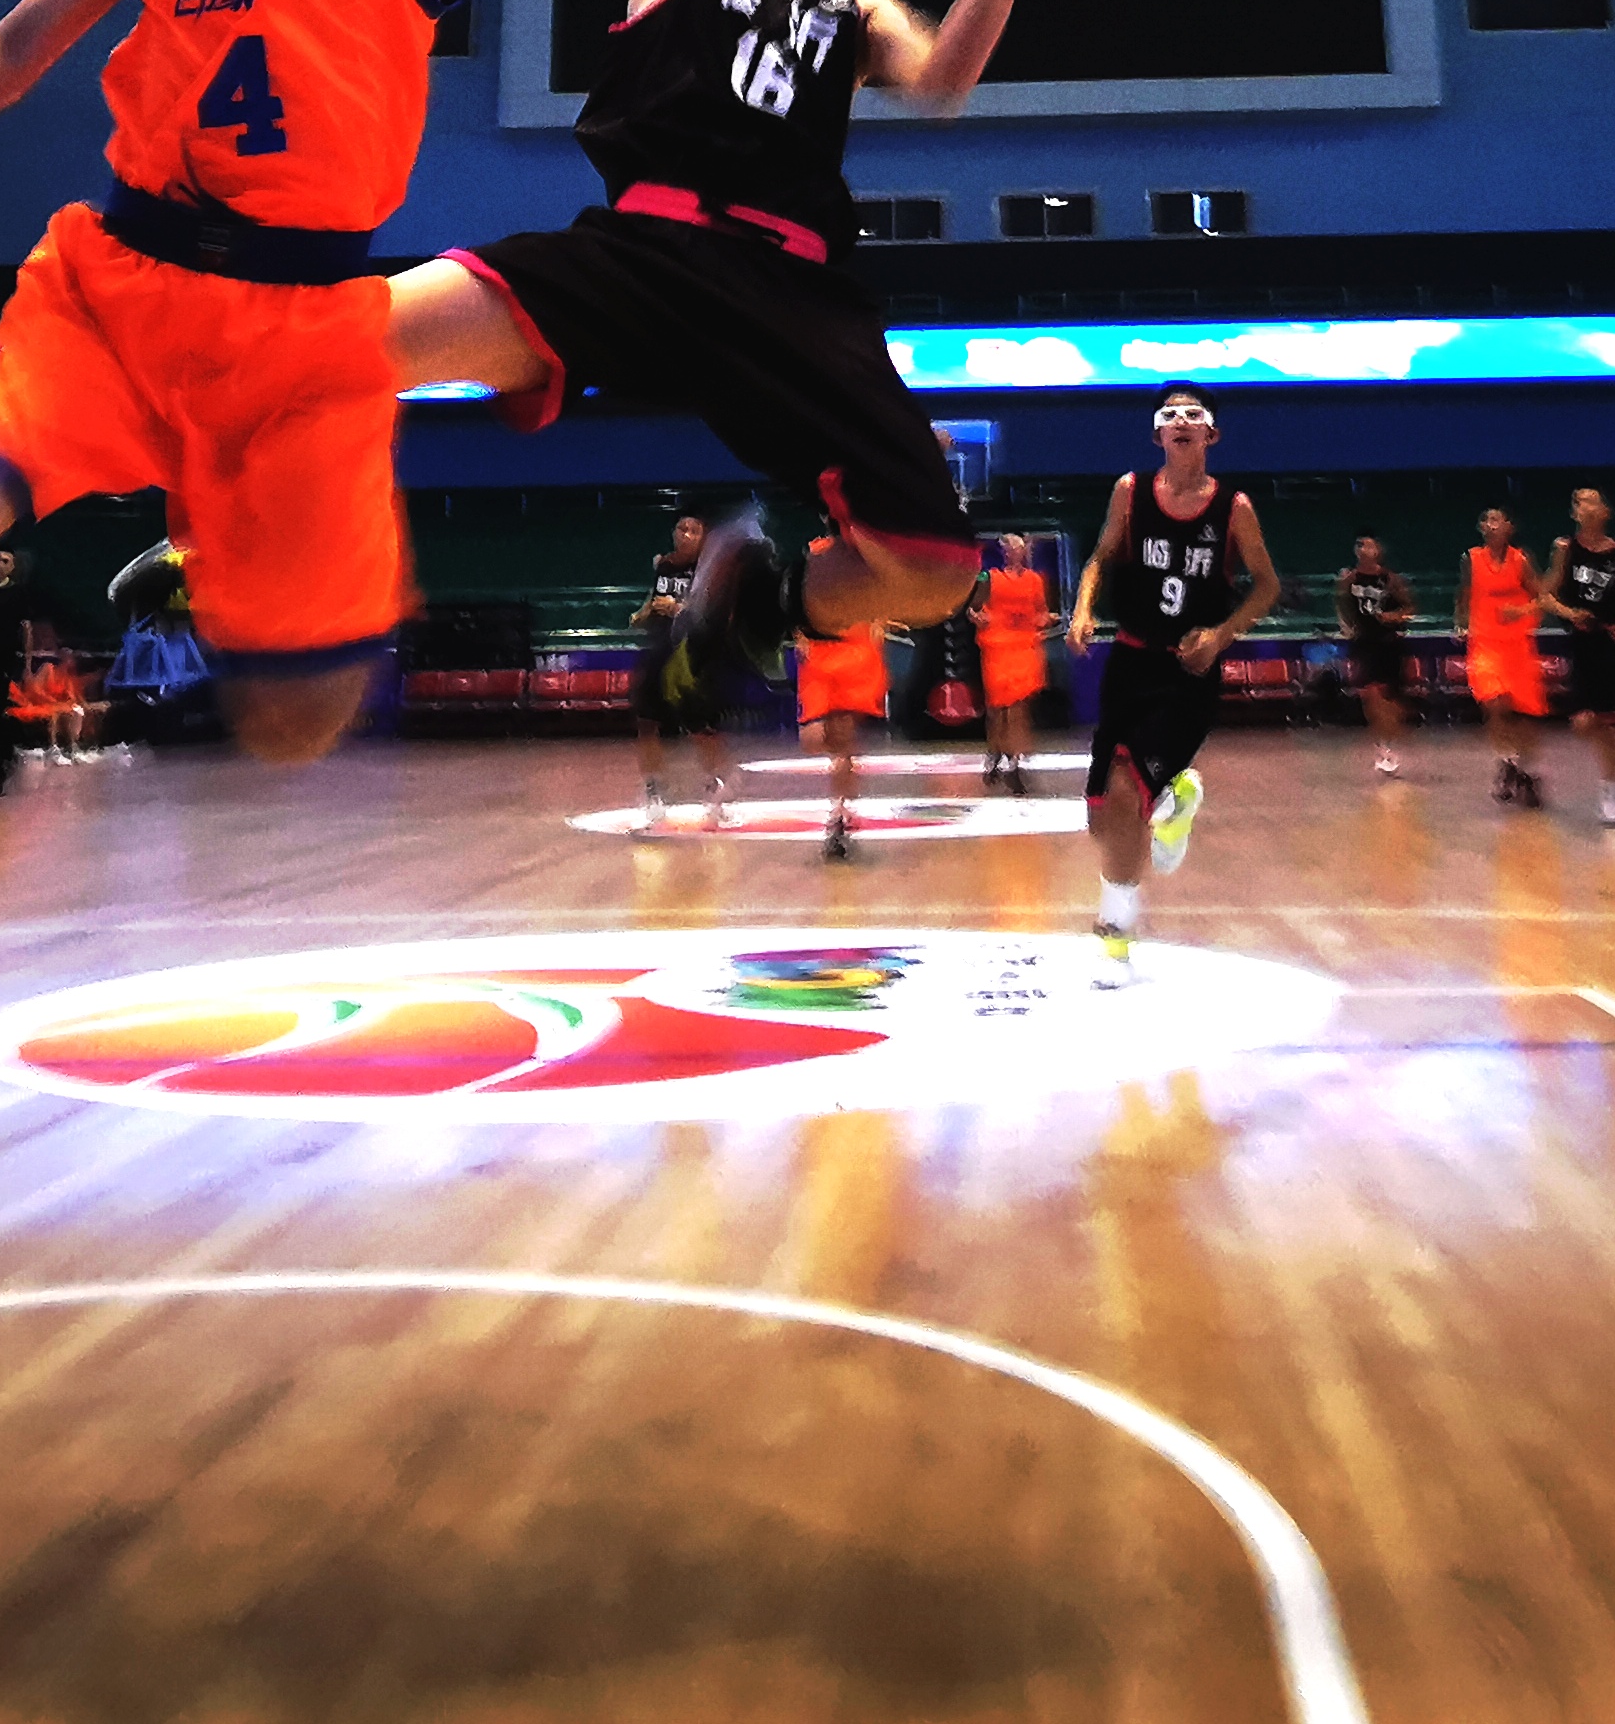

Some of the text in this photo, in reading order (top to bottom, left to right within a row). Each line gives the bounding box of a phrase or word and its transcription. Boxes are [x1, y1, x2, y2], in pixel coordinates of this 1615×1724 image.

[197, 35, 287, 156] 4
[731, 27, 795, 118] 16
[1159, 576, 1185, 616] 9
